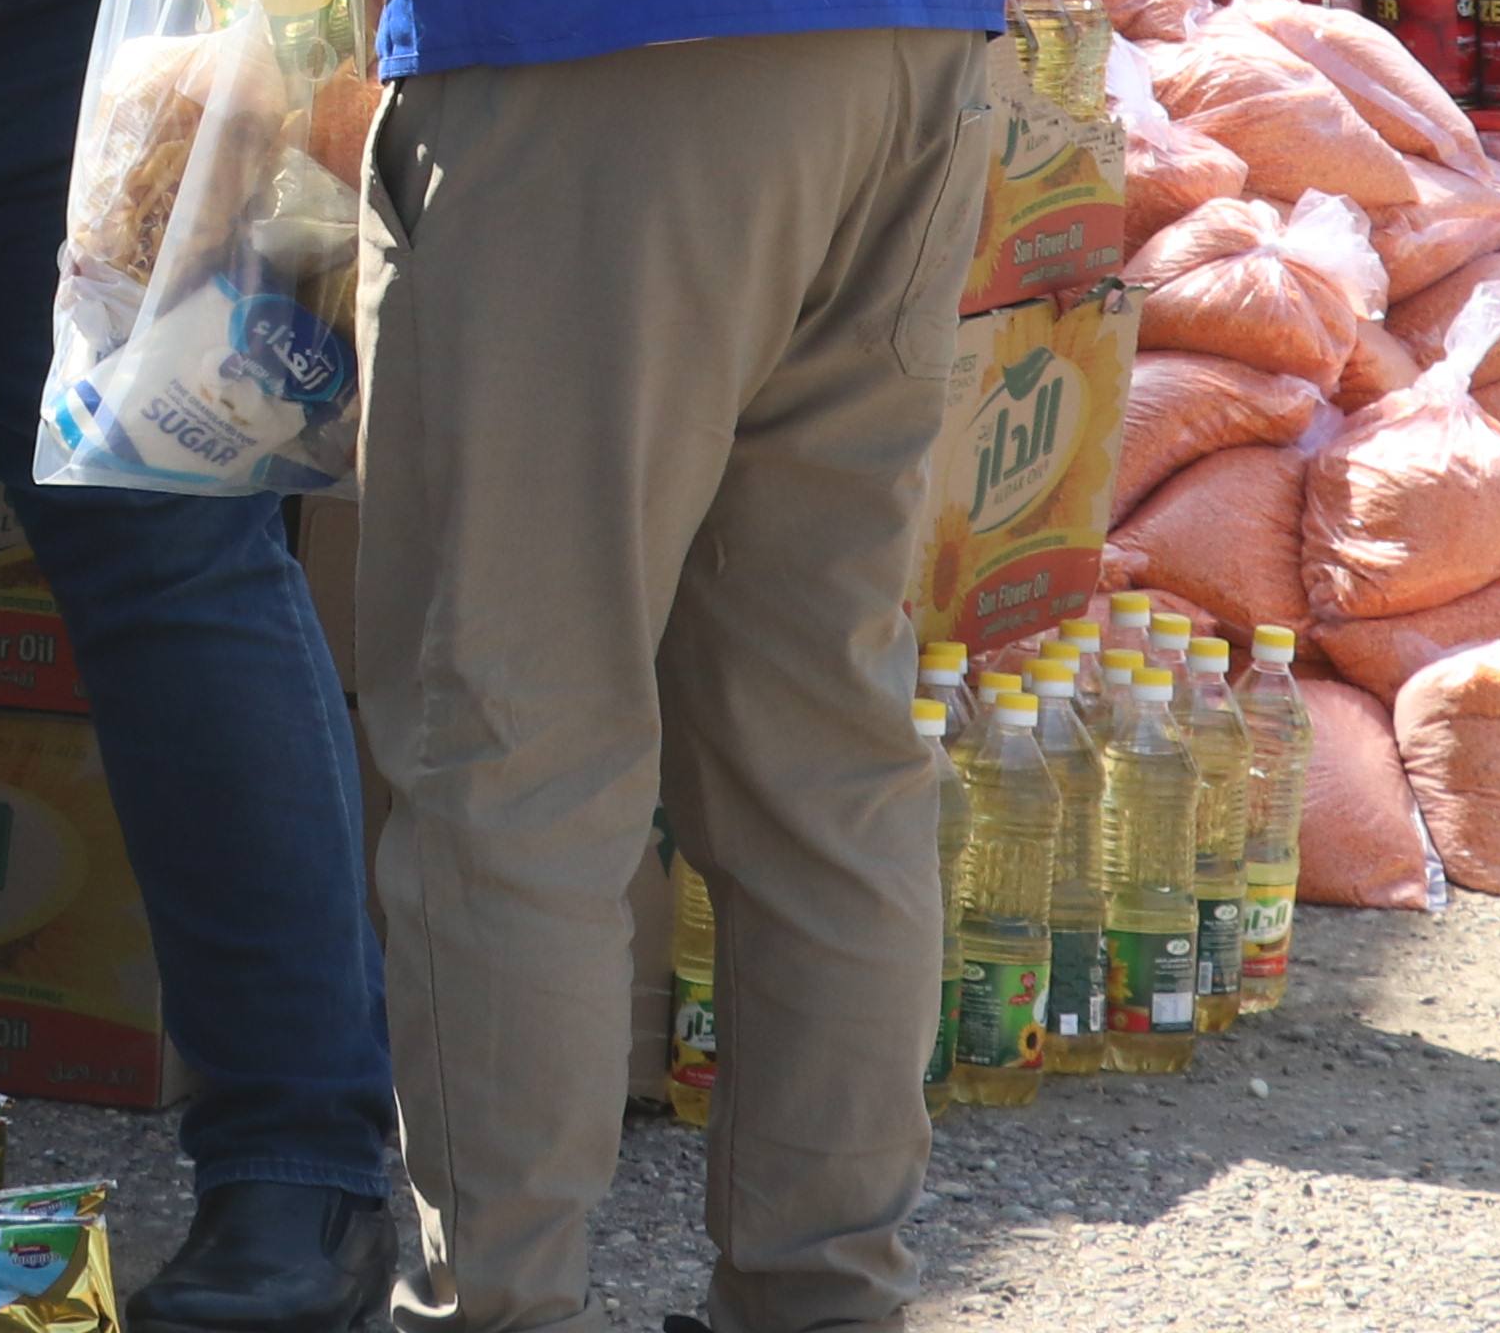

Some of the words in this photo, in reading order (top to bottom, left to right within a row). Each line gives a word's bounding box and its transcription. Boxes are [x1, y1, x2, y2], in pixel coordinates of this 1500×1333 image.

[140, 396, 239, 467] SUGAR
[968, 377, 1064, 524] الدار
[18, 634, 56, 662] Oil
